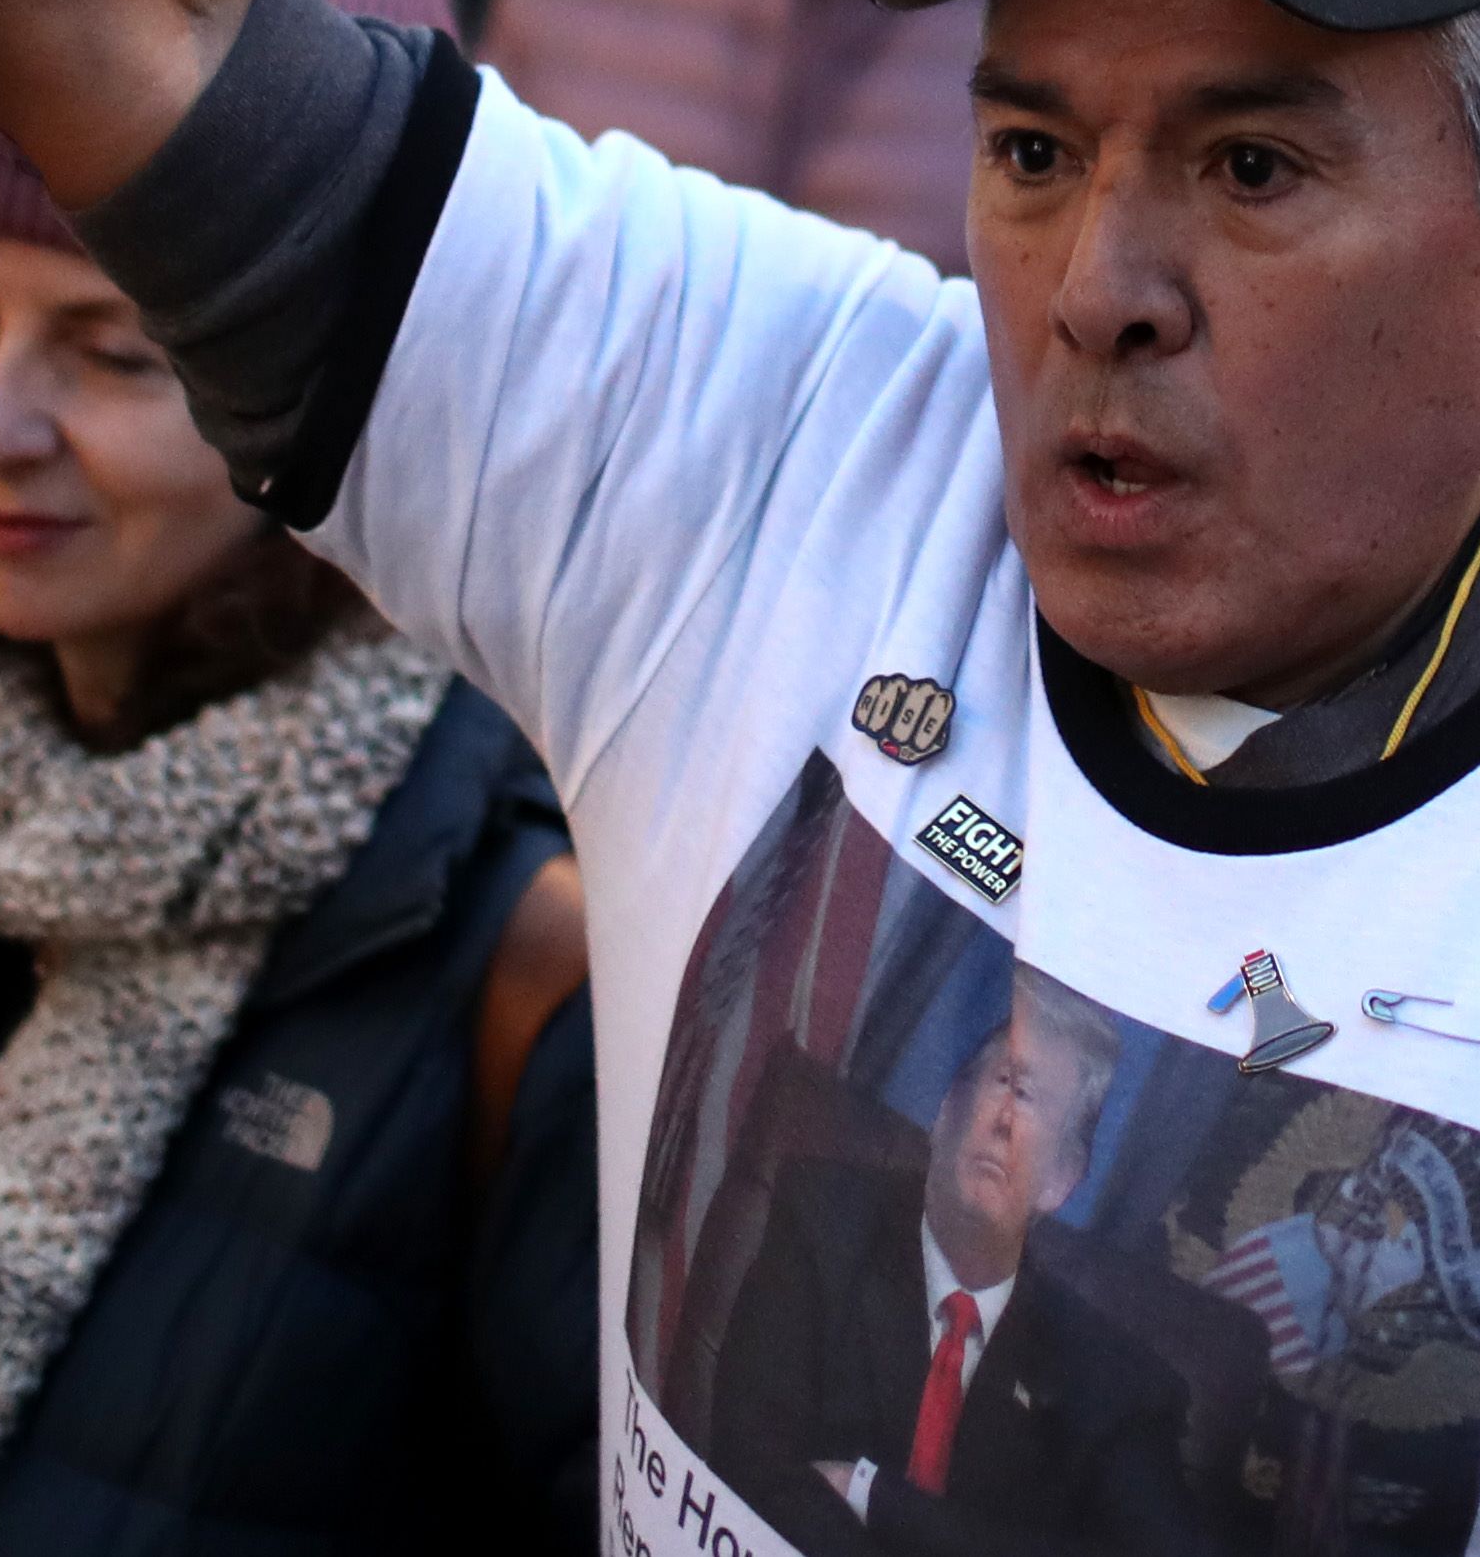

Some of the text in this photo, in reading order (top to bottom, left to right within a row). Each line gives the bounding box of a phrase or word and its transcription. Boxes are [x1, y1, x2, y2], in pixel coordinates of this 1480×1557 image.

[860, 693, 938, 735] RISE
[926, 825, 1007, 894] THE POWER
[939, 801, 1023, 876] FIGHT
[1244, 956, 1280, 992] NO!
[625, 1368, 754, 1557] The Ho
